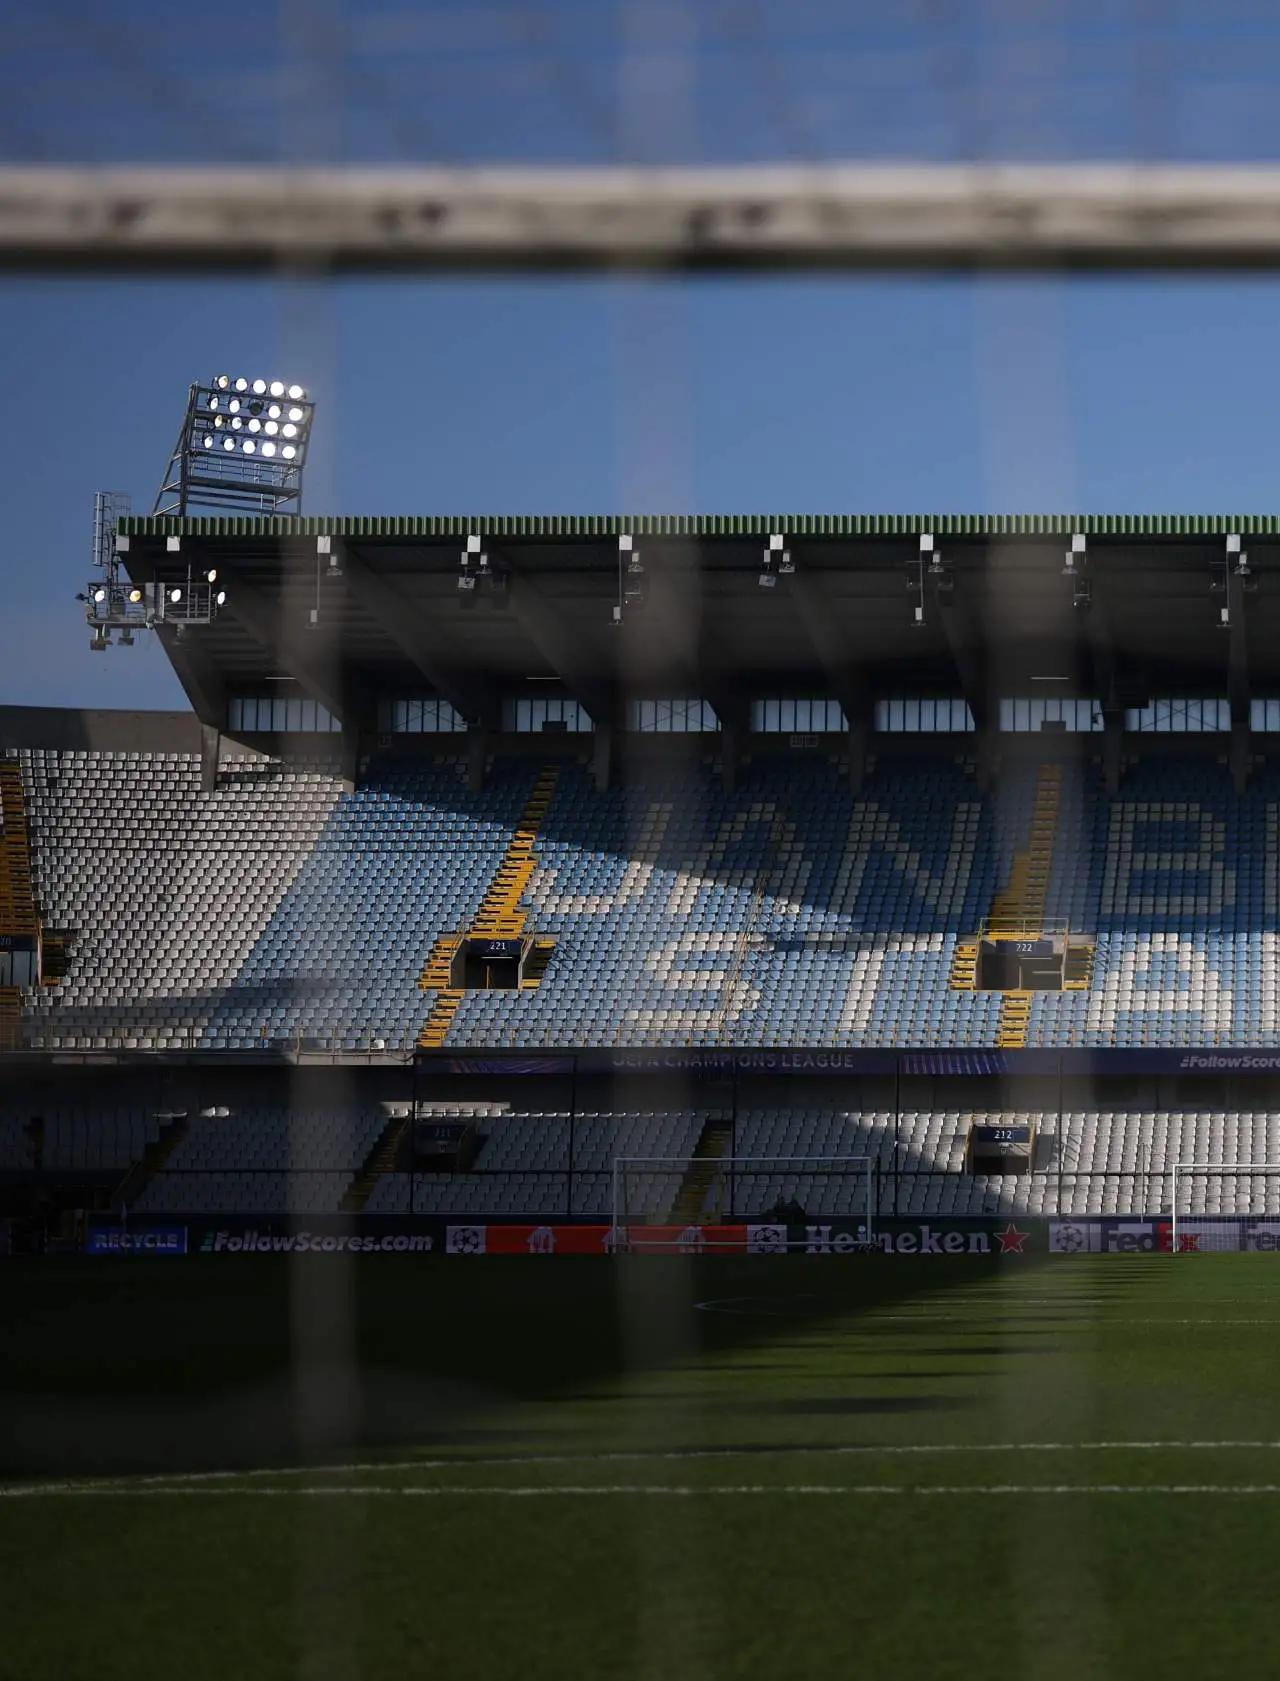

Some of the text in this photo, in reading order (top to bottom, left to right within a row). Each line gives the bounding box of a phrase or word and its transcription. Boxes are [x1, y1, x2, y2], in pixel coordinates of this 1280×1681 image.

[490, 941, 506, 950] 221
[1016, 943, 1032, 952] 222
[782, 1053, 853, 1068] LEAGUE
[994, 1130, 1012, 1139] 212
[94, 1232, 178, 1248] RECYCLE
[805, 1225, 991, 1253] Heineken
